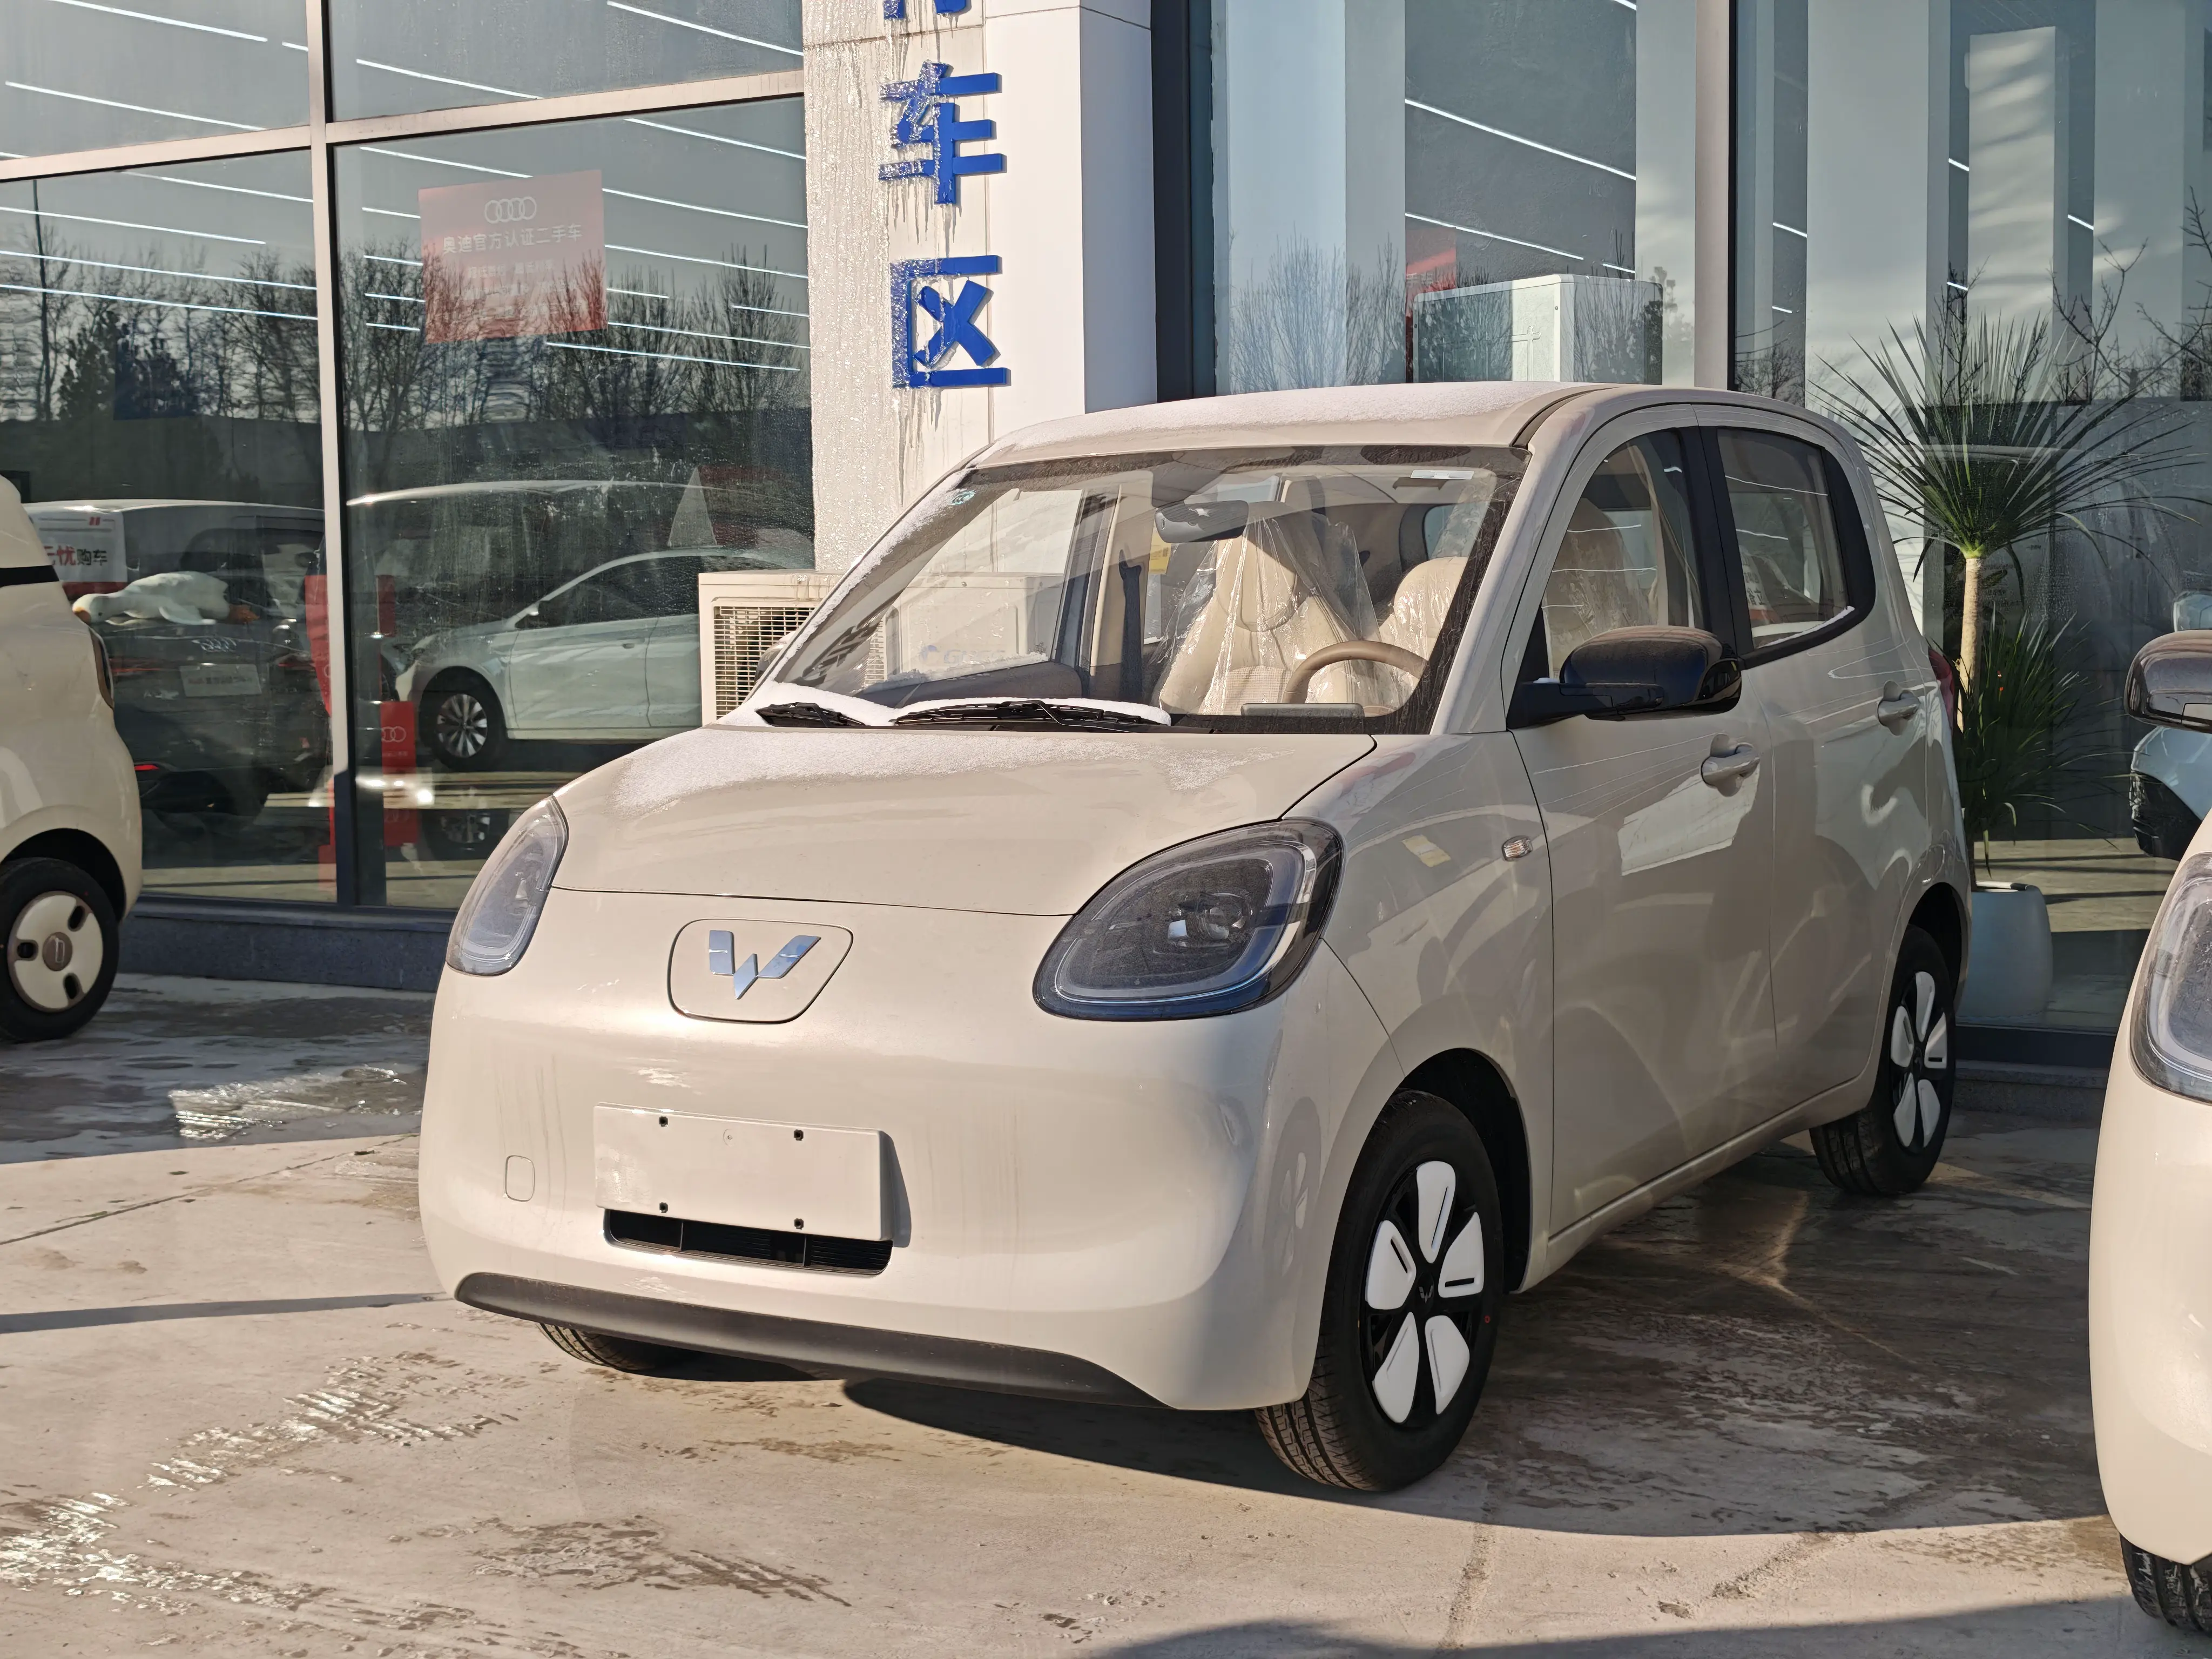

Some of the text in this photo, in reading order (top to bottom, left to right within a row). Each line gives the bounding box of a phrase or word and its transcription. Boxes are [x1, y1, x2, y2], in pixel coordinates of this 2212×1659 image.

[443, 222, 583, 255] 奥迪官方认证二手车
[878, 0, 1010, 388] 车区
